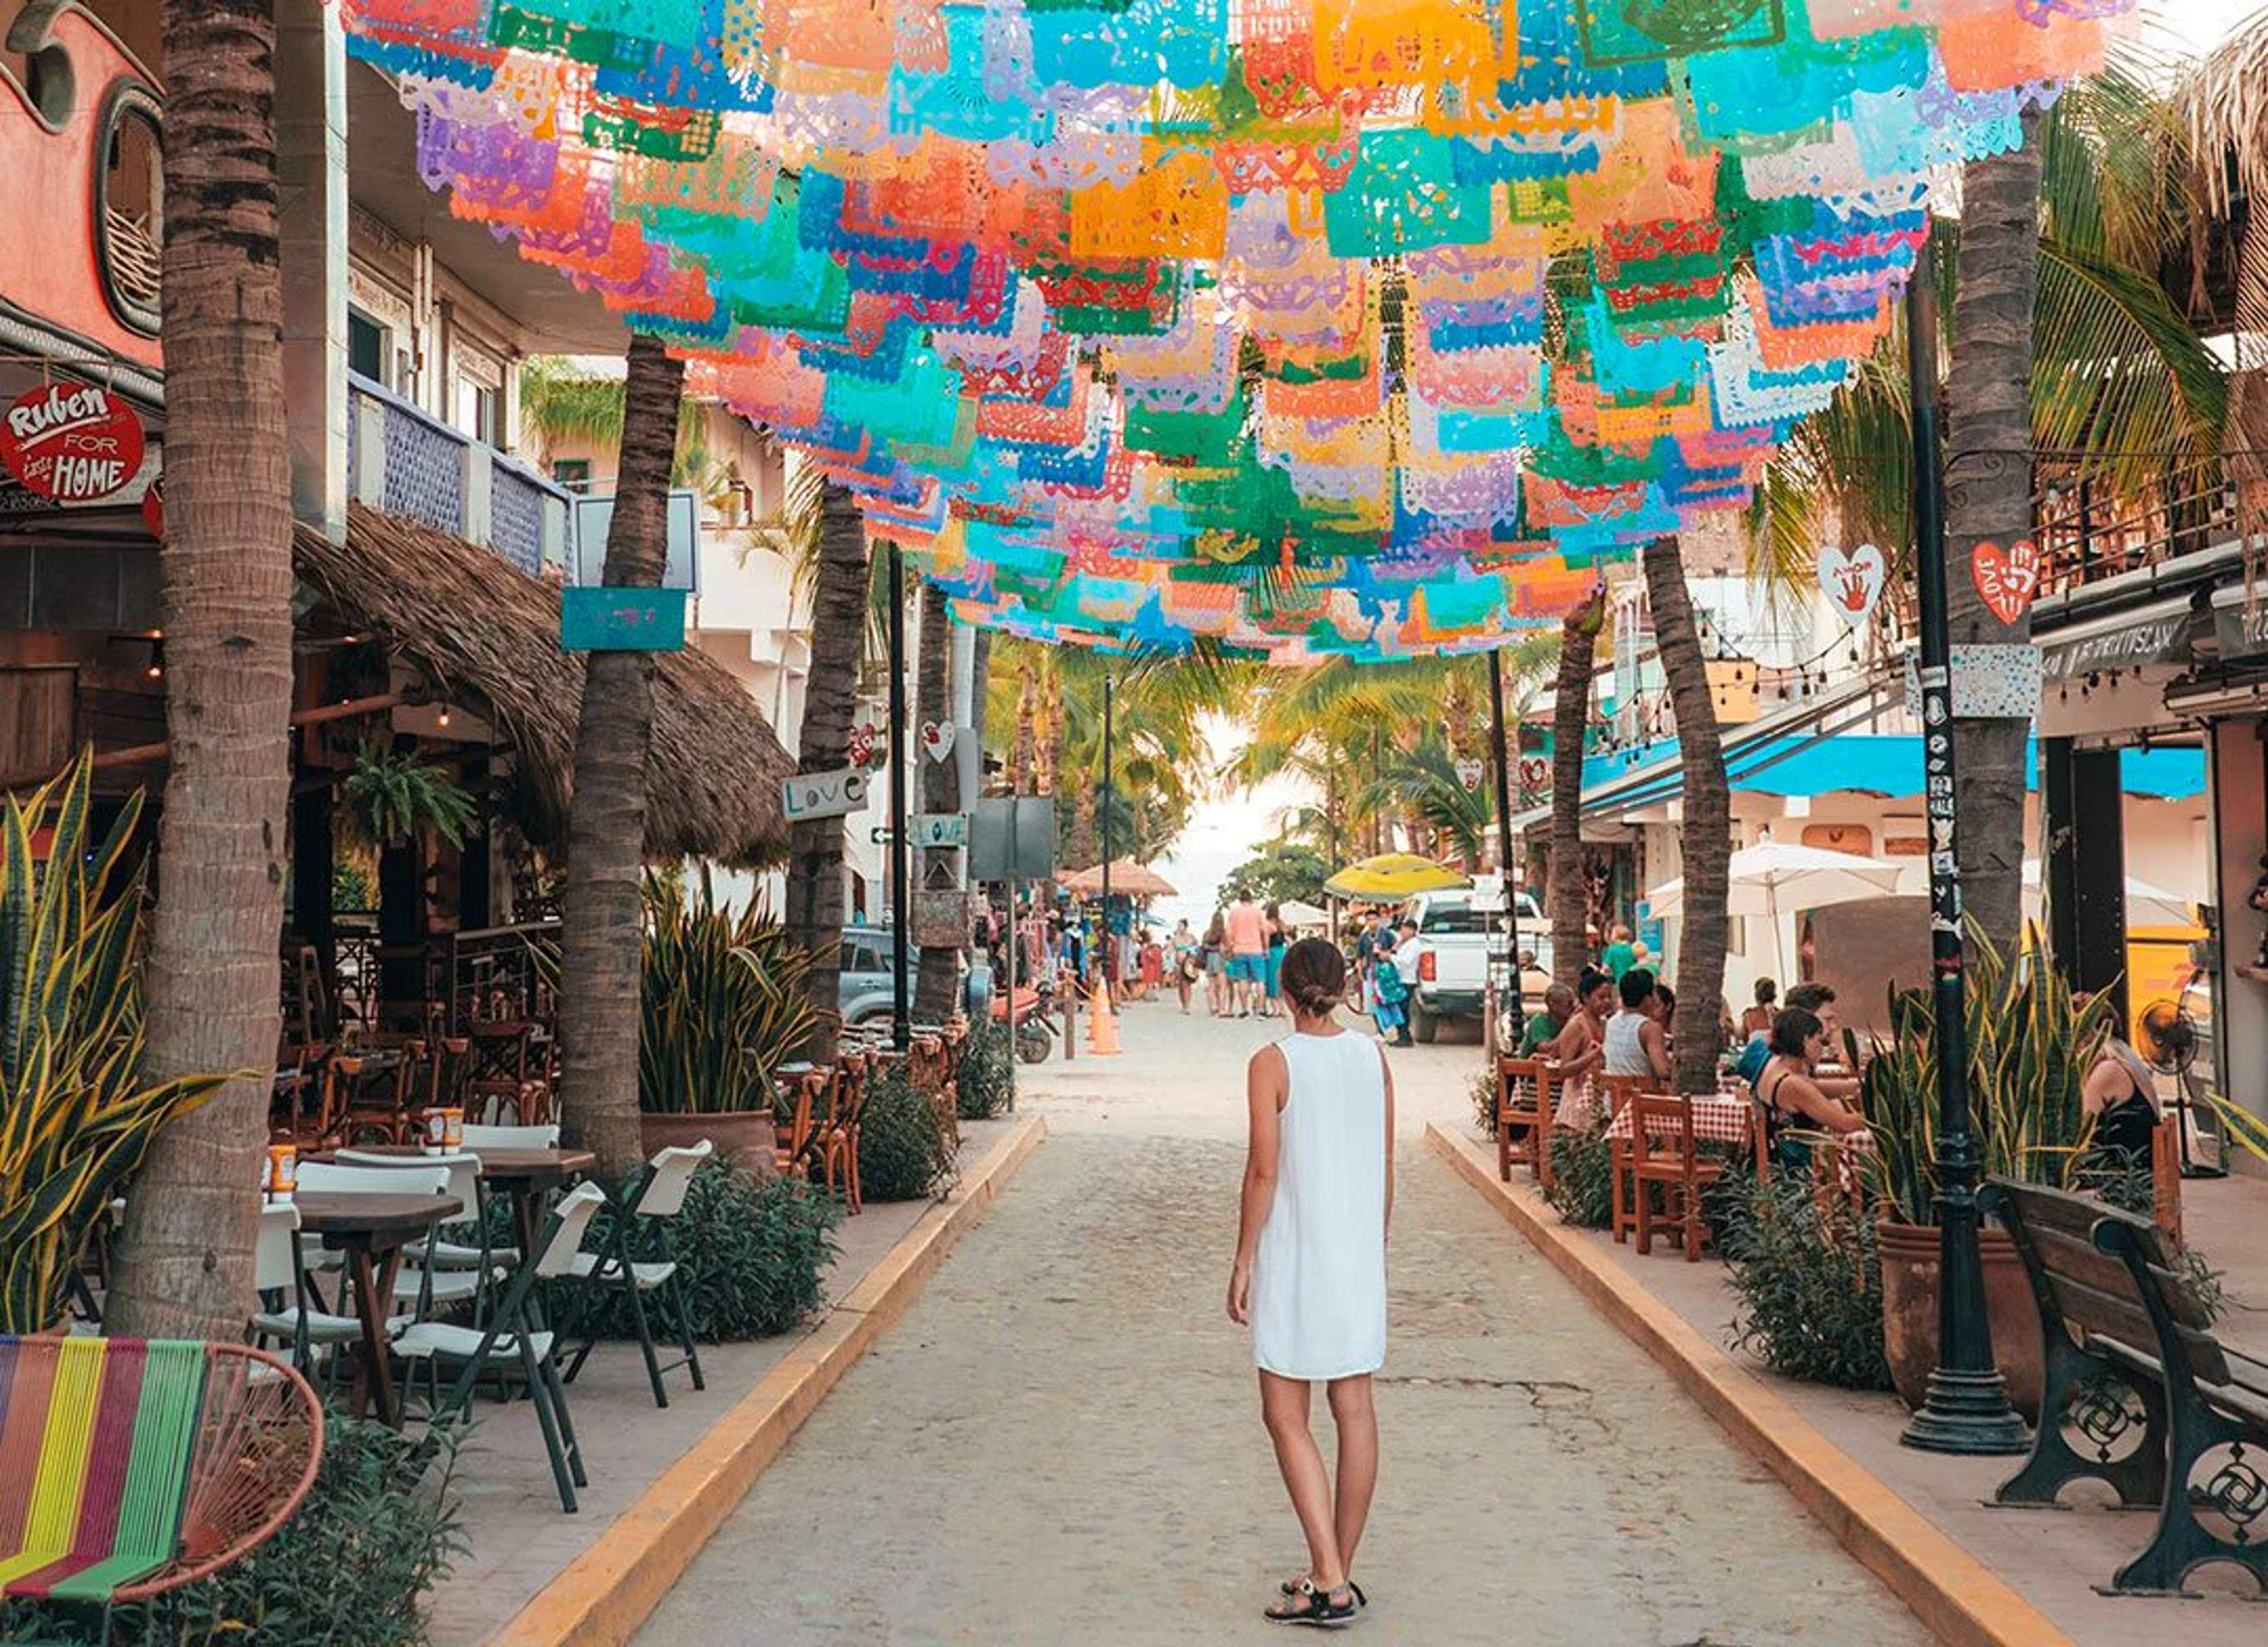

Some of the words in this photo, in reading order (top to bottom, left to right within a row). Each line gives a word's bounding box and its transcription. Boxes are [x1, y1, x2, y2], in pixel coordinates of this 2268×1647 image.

[8, 386, 108, 438] Ruben
[64, 434, 118, 454] FOR
[52, 455, 125, 497] HOME
[1977, 558, 2005, 604] LOVE
